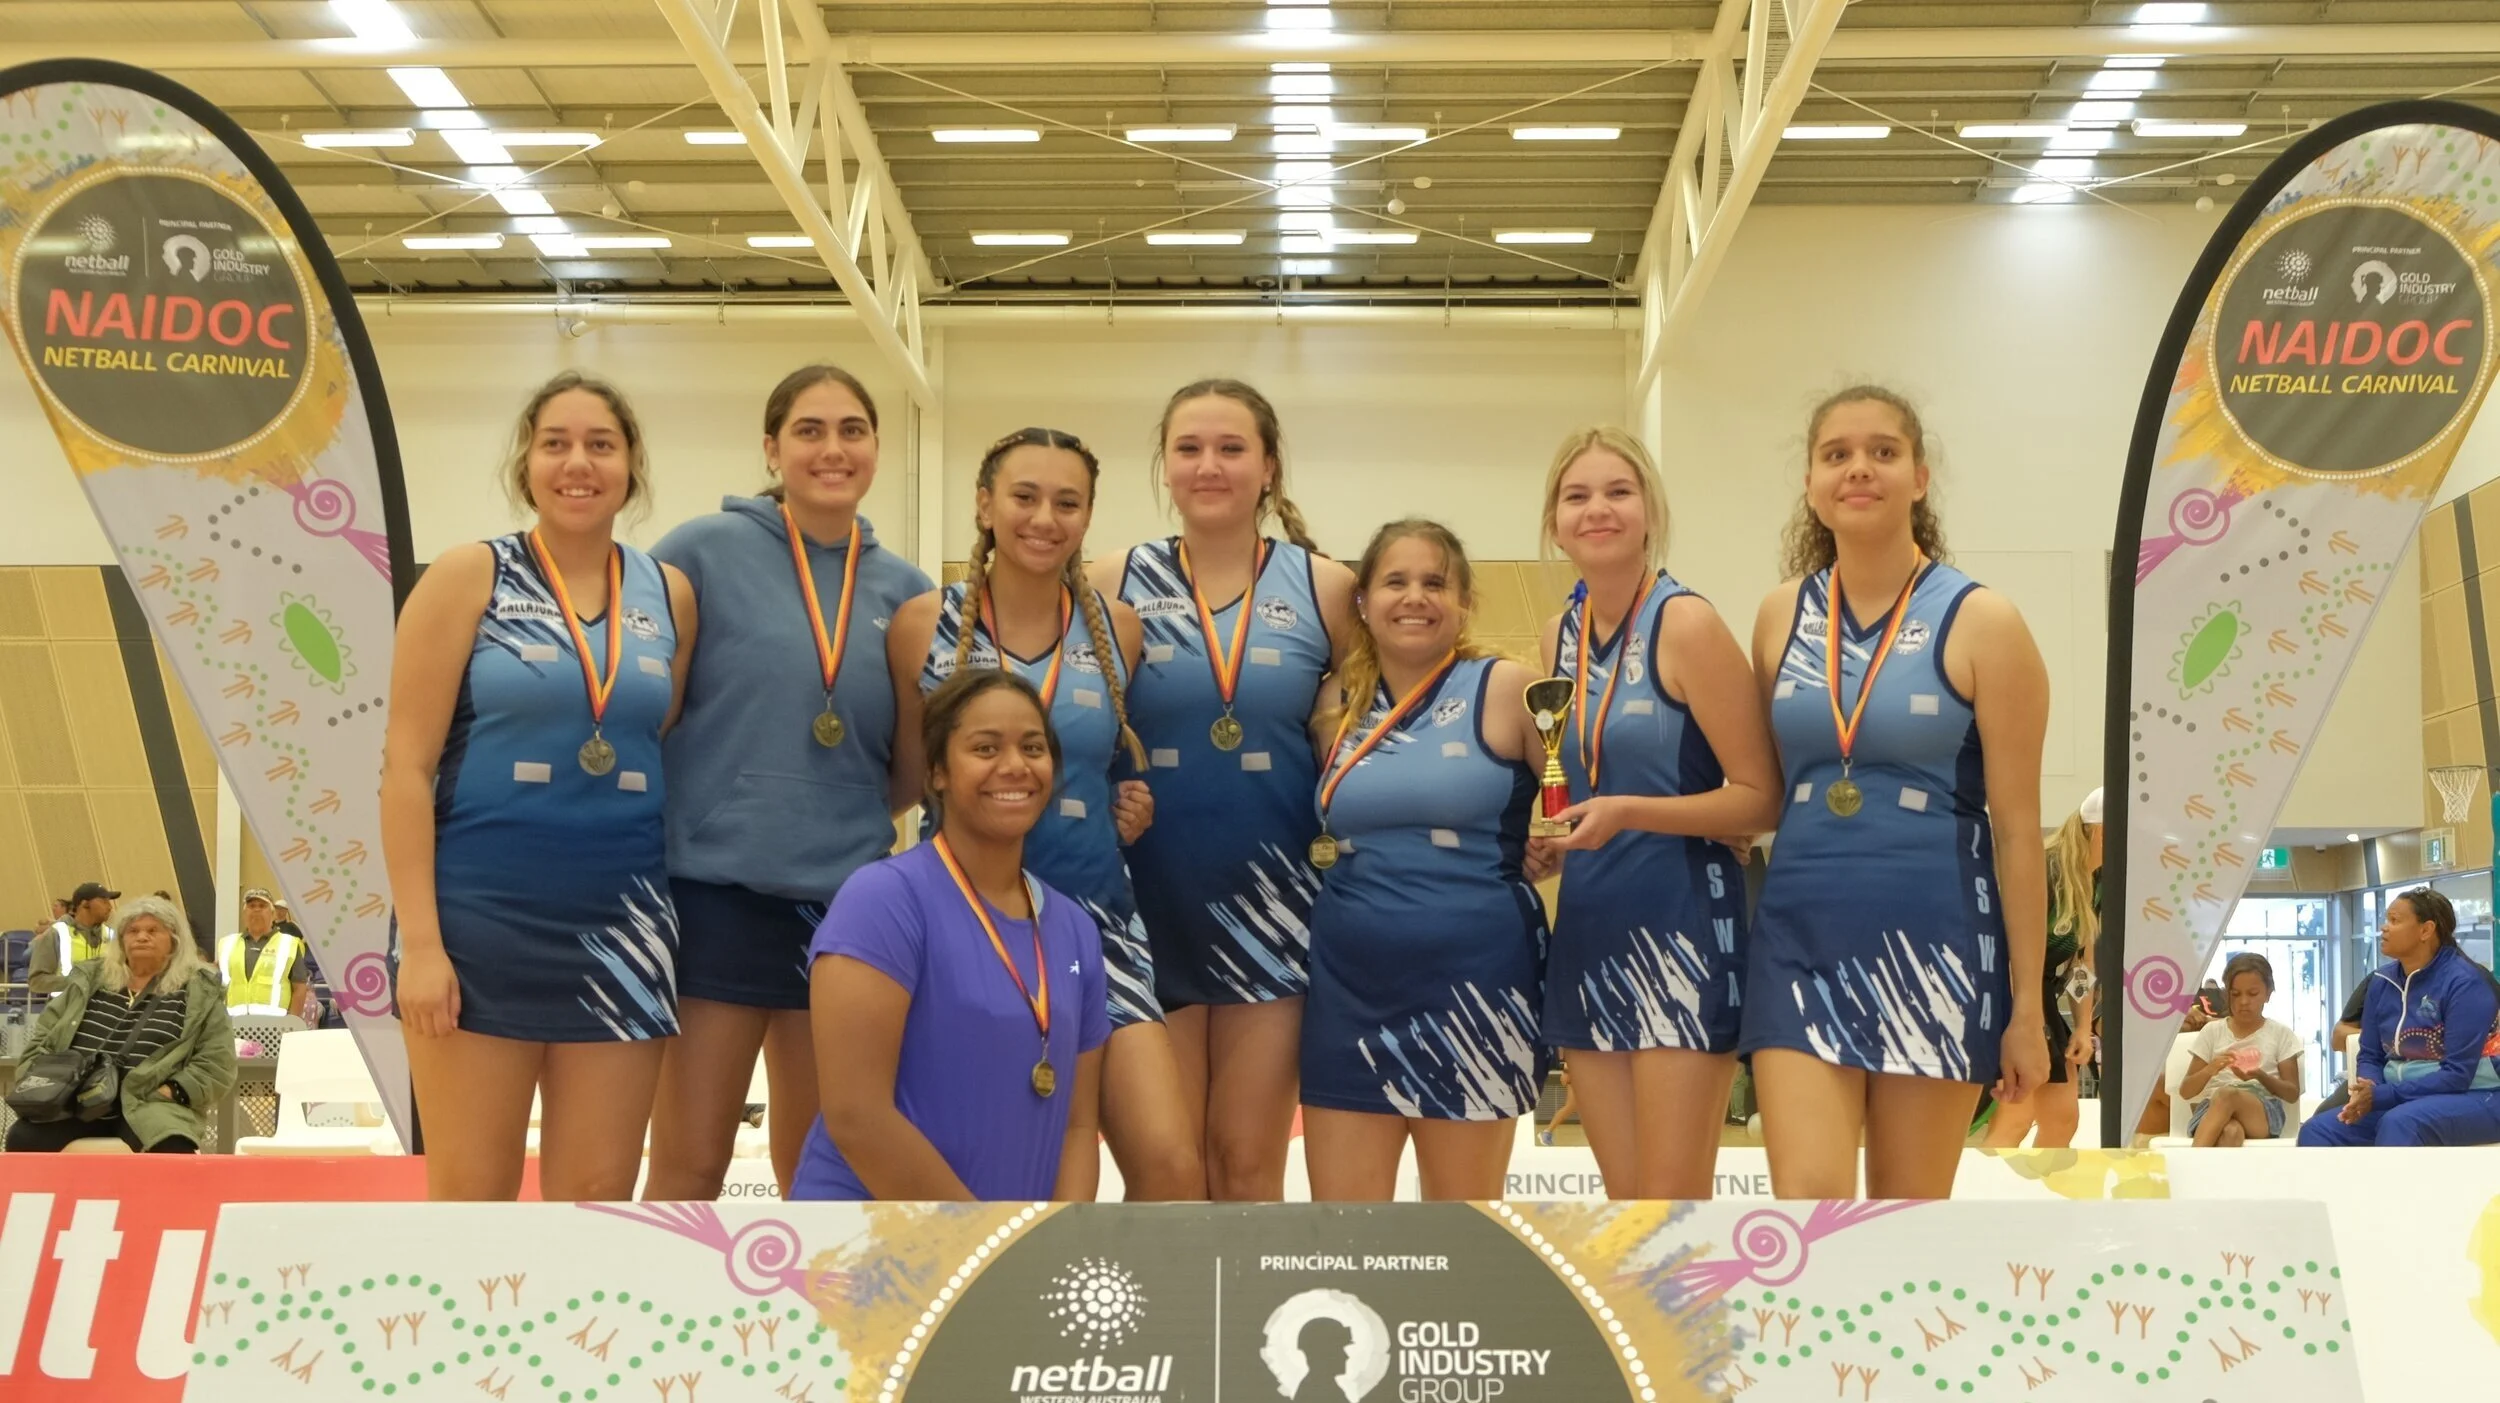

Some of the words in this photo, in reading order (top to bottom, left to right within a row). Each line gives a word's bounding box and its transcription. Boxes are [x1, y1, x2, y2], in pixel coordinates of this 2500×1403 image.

[65, 254, 130, 271] netball
[213, 249, 244, 261] GOLD
[214, 261, 270, 276] INDUSTRY
[2400, 272, 2430, 284] GOLD
[2263, 286, 2319, 300] netball
[2400, 283, 2456, 294] INDUSTRY
[45, 289, 293, 349] NAIDOC
[2238, 320, 2473, 365] NAIDOC
[43, 346, 157, 372] NETBALL
[166, 352, 291, 379] CARNIVAL
[2230, 374, 2332, 394] NETBALL
[2342, 374, 2459, 394] CARNIVAL
[1706, 862, 1741, 1007] SWA
[1506, 1174, 1604, 1195] RINCIP
[1260, 1255, 1358, 1270] PRINCIPAL
[1363, 1255, 1449, 1270] PARTNER
[1397, 1321, 1479, 1347] GOLD
[1399, 1349, 1551, 1376] INDUSTRY
[1010, 1355, 1173, 1392] netball
[1399, 1377, 1504, 1403] GROUP
